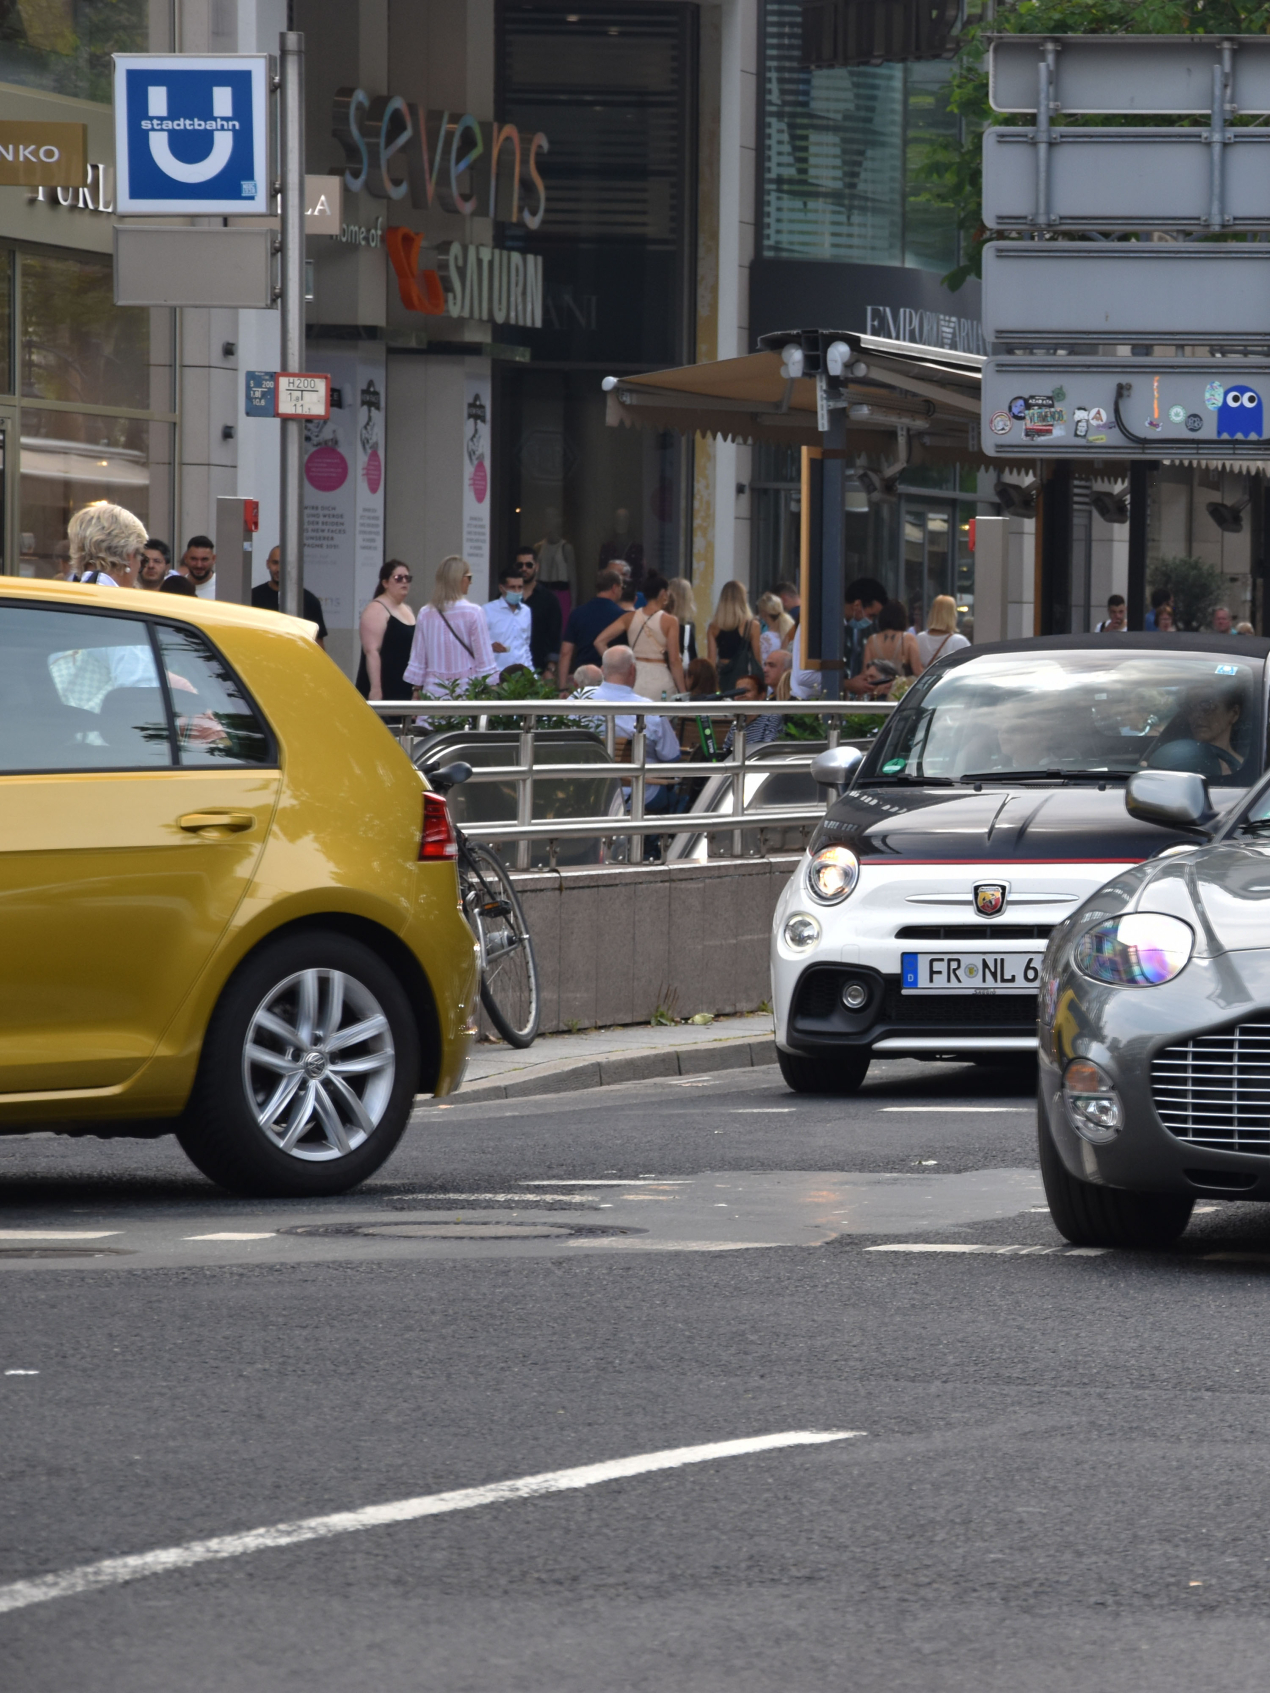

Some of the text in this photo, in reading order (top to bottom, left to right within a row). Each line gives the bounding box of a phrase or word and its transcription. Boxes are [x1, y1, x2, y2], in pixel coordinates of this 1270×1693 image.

[141, 117, 240, 130] stadtbahn
[344, 88, 549, 230] sevens
[369, 216, 383, 248] of
[448, 241, 543, 329] SATURN
[261, 380, 275, 388] 200
[907, 974, 914, 982] D
[928, 957, 962, 984] FR
[982, 957, 1016, 984] NL
